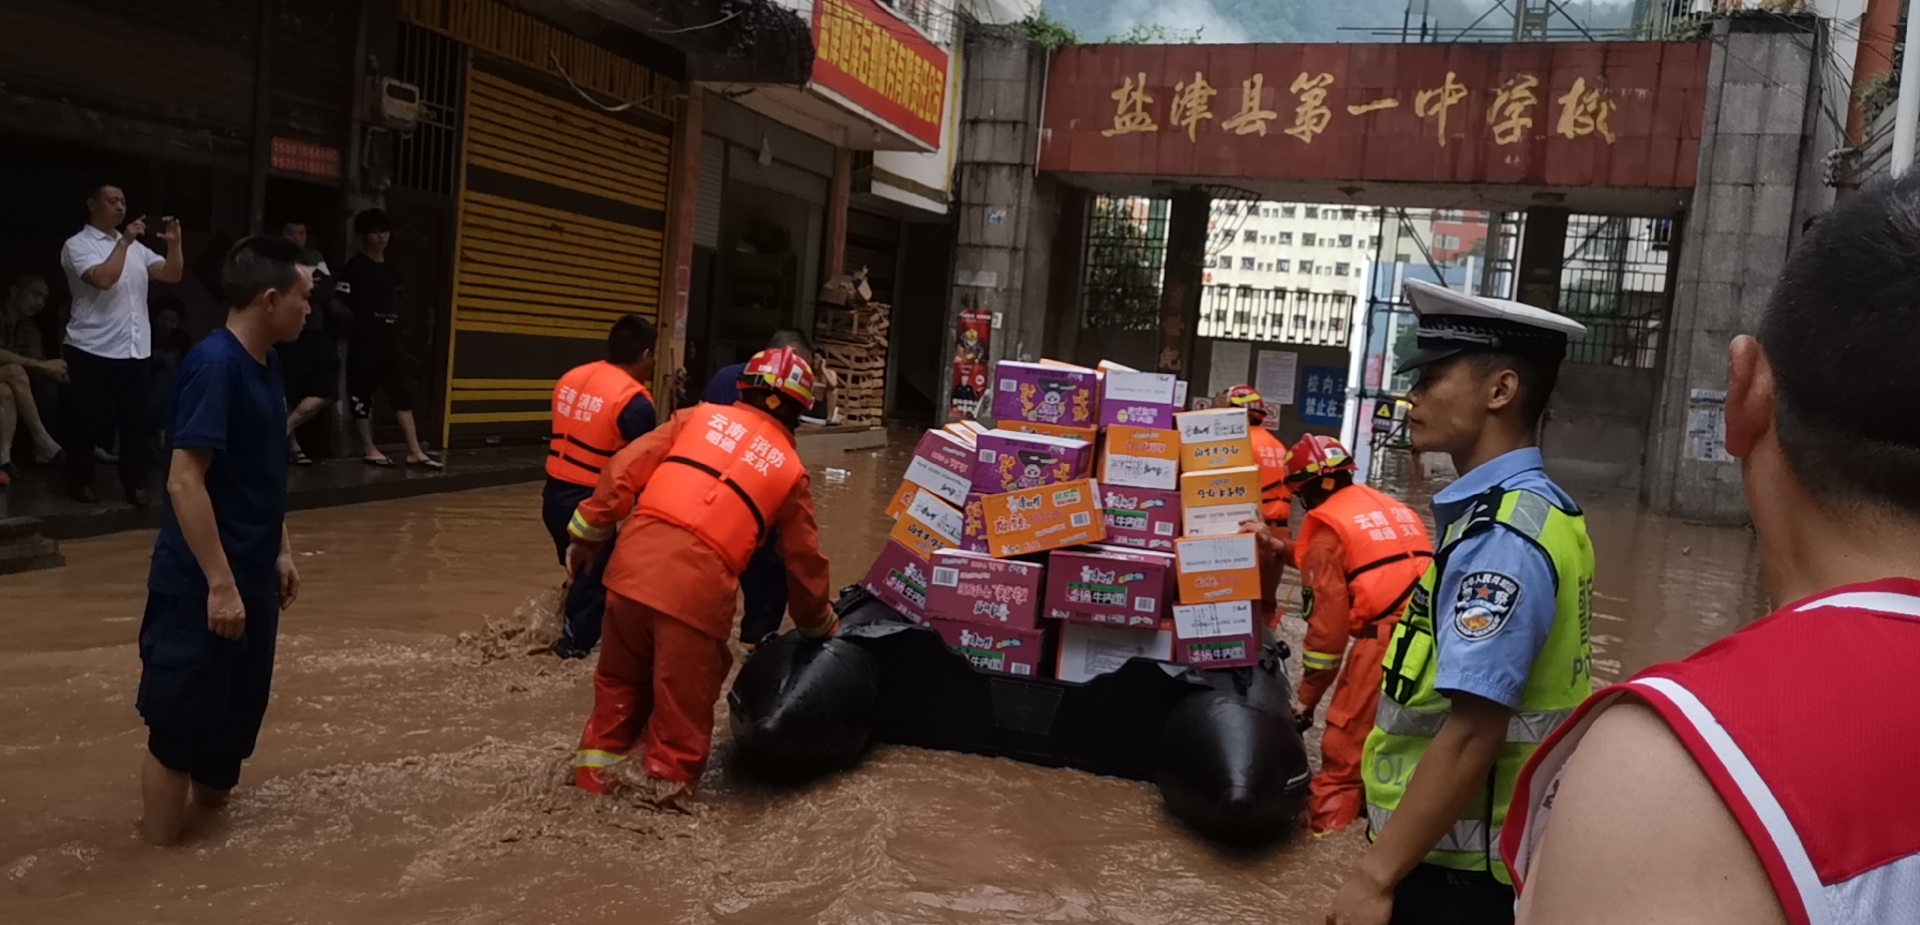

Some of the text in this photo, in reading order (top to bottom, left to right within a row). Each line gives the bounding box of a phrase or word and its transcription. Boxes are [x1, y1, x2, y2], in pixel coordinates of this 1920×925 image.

[1101, 71, 1617, 147] 盐津县第一中学校
[557, 385, 604, 413] 云南 消防
[704, 429, 769, 477] 昭通 支队
[706, 413, 787, 468] 云南 消防
[1354, 510, 1390, 530] 云南
